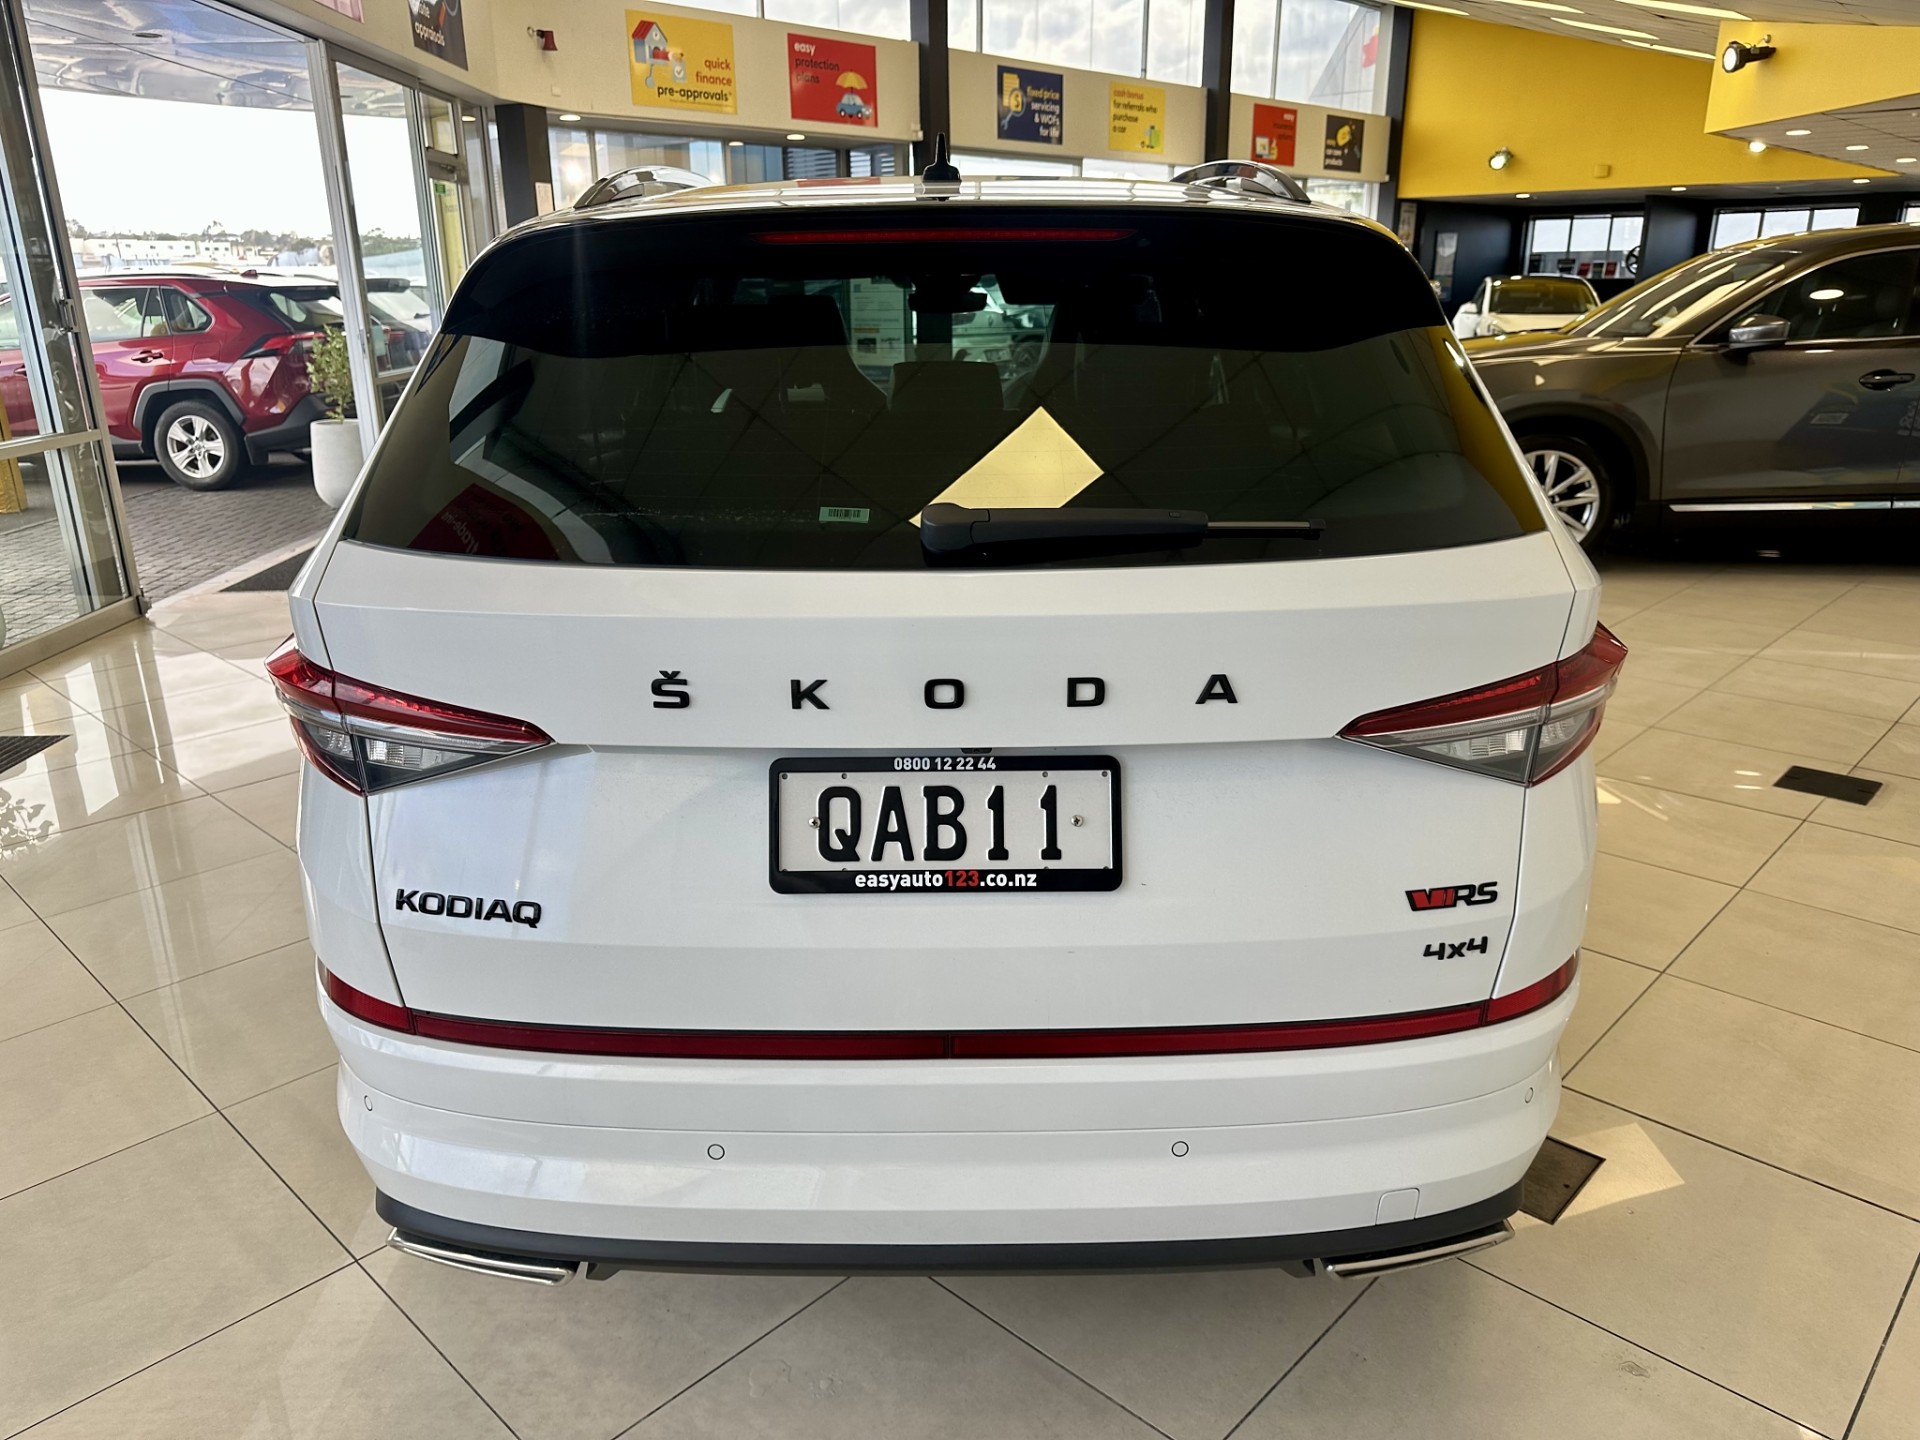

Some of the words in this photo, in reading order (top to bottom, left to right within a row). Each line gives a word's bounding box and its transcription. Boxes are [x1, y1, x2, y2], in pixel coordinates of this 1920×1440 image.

[414, 22, 445, 46] appraisals
[794, 42, 816, 56] easy
[704, 58, 731, 70] quick
[795, 58, 839, 72] protection
[696, 71, 732, 86] finance
[796, 71, 820, 84] plans
[1043, 89, 1060, 100] price
[1031, 100, 1060, 114] servicing
[1113, 99, 1121, 108] for
[1034, 113, 1039, 123] &
[1040, 113, 1060, 125] WOFs
[1112, 112, 1138, 123] purchase
[1039, 125, 1049, 136] for
[893, 757, 930, 770] 0800
[935, 757, 952, 770] 12
[956, 757, 974, 770] 22
[977, 757, 996, 770] 44
[818, 785, 1062, 862] QAB11
[855, 871, 1037, 890] easyauto123.co.nz
[395, 888, 542, 928] KODIAQ
[1423, 935, 1488, 960] 4x4
